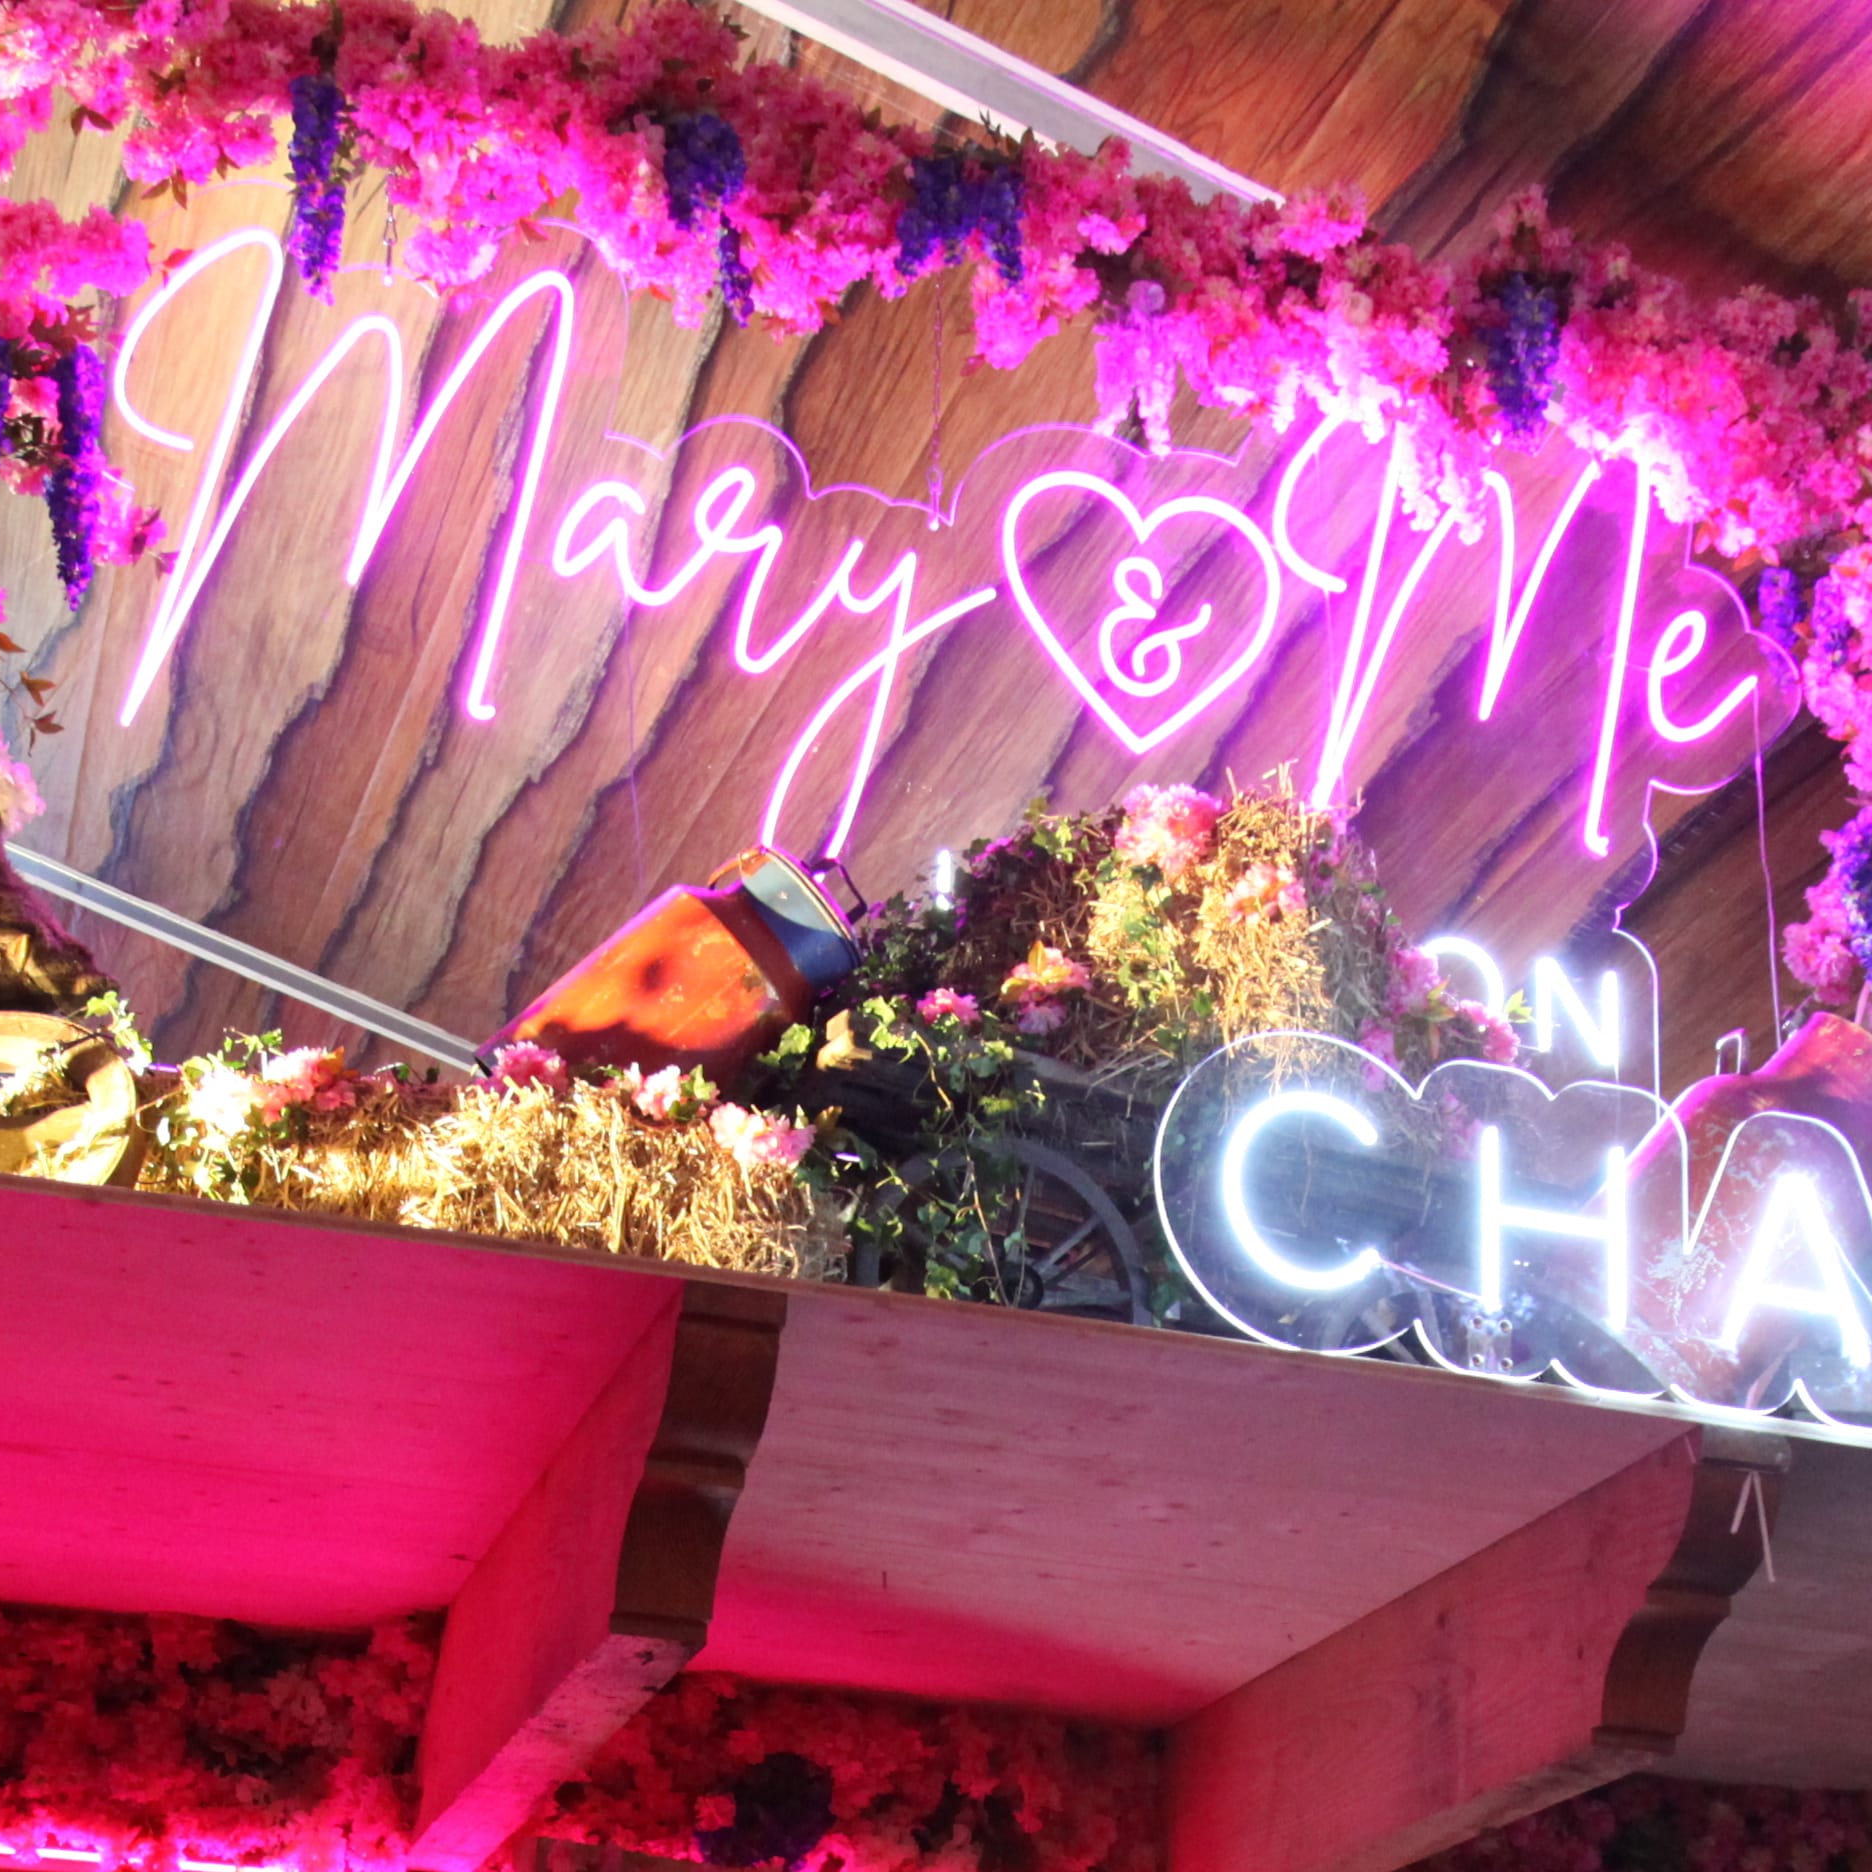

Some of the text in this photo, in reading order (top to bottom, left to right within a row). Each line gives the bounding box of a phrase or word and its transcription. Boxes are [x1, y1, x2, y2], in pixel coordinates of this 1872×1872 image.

[116, 226, 1761, 886] Mary & Me
